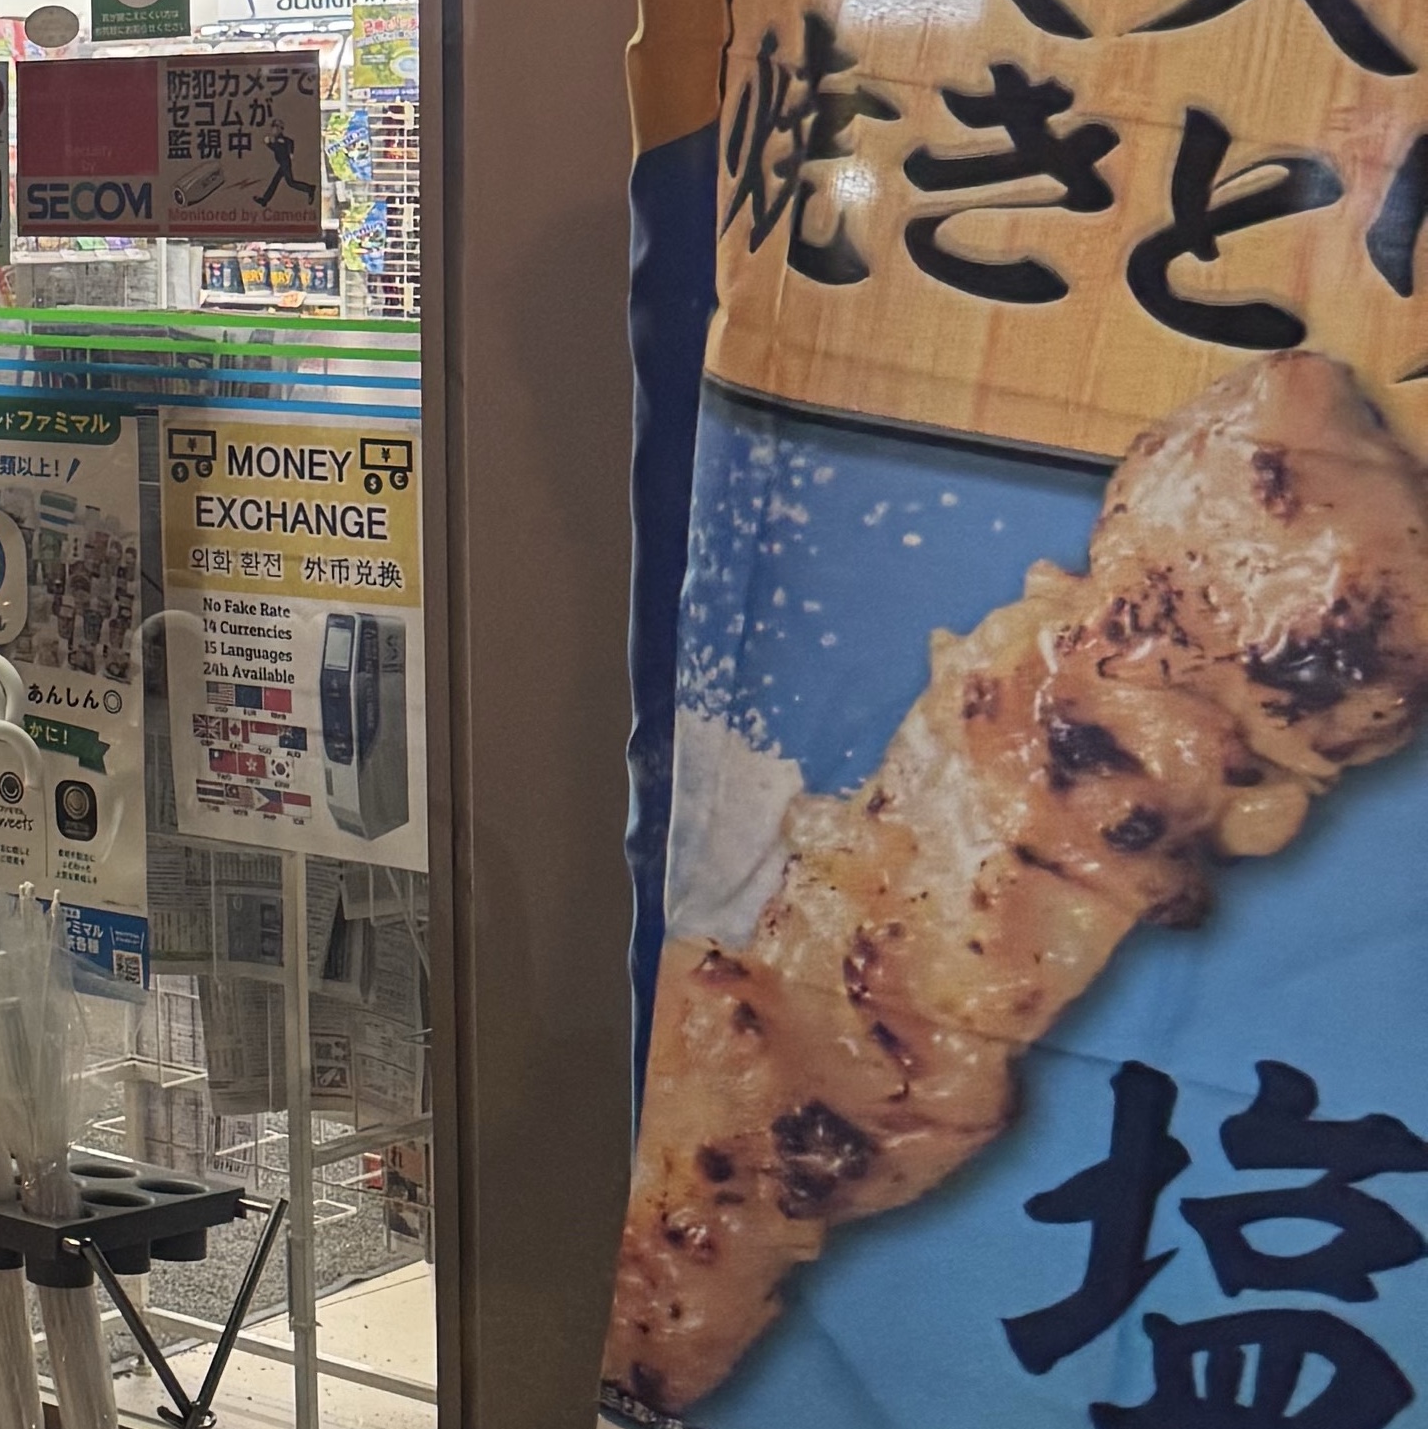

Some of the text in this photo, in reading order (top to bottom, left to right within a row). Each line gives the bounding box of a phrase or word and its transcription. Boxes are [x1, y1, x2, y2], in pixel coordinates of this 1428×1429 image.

[167, 68, 316, 102] 防犯カメラで
[167, 97, 274, 129] セコムが
[167, 128, 252, 160] 監視中
[27, 180, 153, 222] SECOM
[168, 207, 317, 224] Monitored by Camera
[17, 409, 111, 435] ファミマル
[227, 444, 353, 483] MONEY
[195, 495, 389, 541] EXCHANGE
[191, 547, 282, 579] 외화 환전
[304, 556, 404, 589] 外币兑换
[203, 597, 291, 619] No Fake Rate
[203, 619, 293, 641] 14 Currencies
[204, 639, 293, 664] 15 Languages
[203, 661, 295, 685] 24h Available
